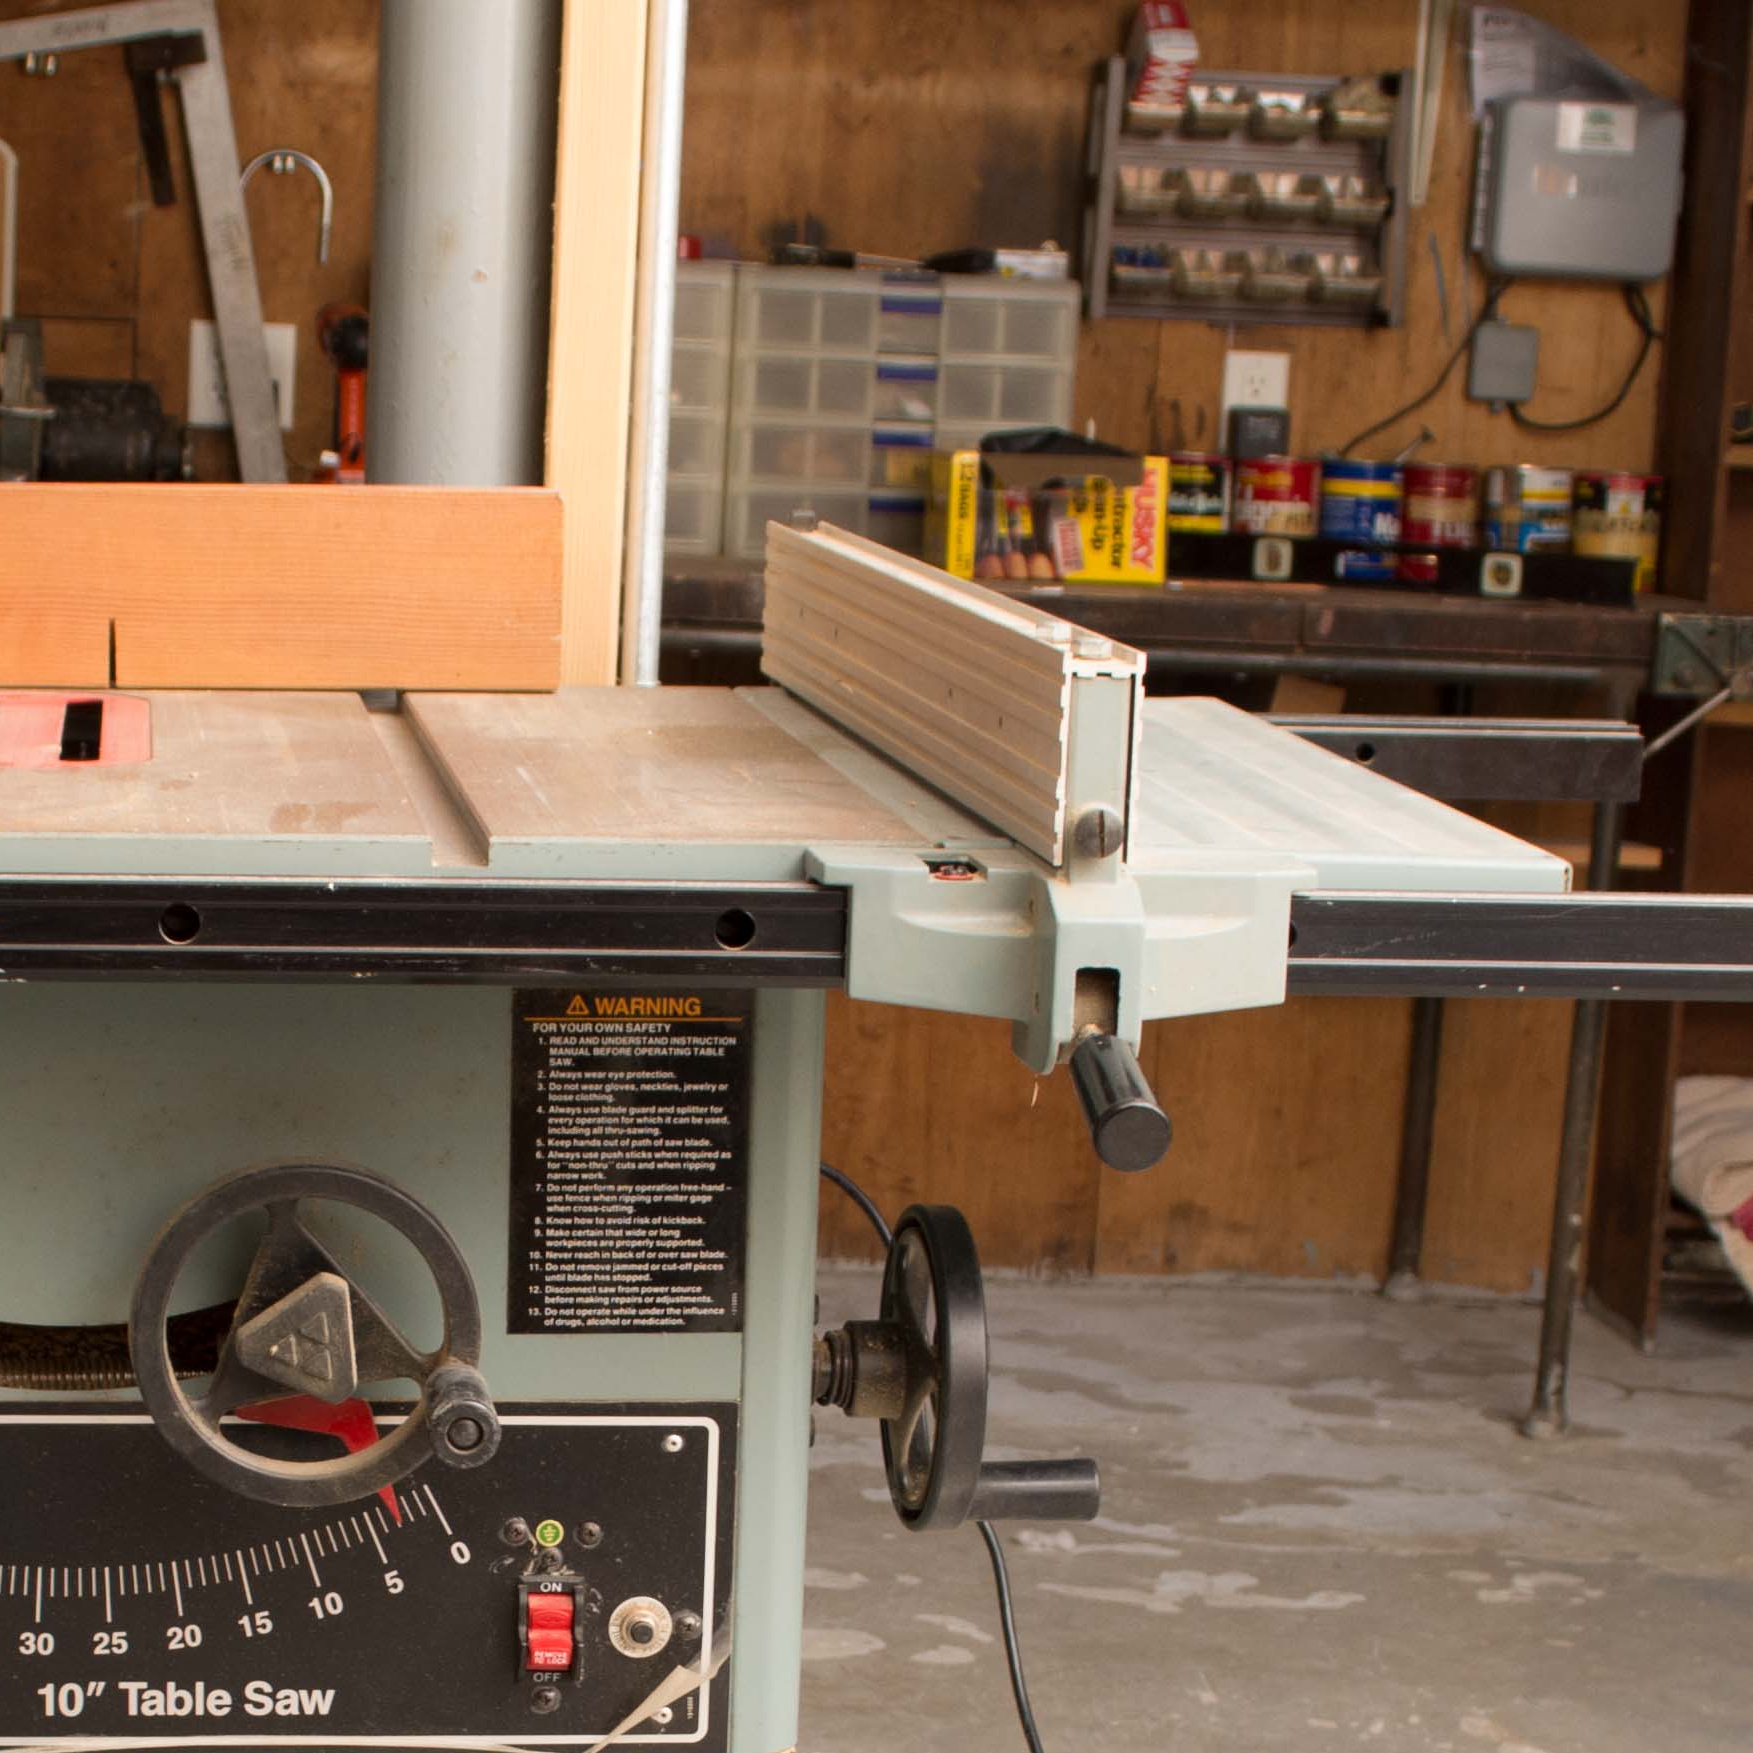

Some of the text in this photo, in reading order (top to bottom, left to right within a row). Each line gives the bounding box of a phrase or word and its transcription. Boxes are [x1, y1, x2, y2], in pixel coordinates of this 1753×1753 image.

[1129, 466, 1159, 571] HUSKY
[595, 997, 701, 1015] WARNING
[533, 1023, 671, 1033] FOR YOUR OWN SAFETY
[550, 1037, 577, 1045] READ
[602, 1037, 668, 1045] UNDERSTAND
[671, 1037, 736, 1045] INSTRUCTION
[550, 1048, 724, 1056] MANUAL BEFORE OPERATING TABLE
[549, 1071, 582, 1080] Always
[683, 1083, 716, 1093] jewelry
[548, 1093, 573, 1101] loose
[548, 1106, 581, 1116] Always
[602, 1106, 627, 1114] blade
[629, 1106, 656, 1116] guard
[676, 1106, 708, 1116] splitter
[548, 1118, 573, 1126] every
[575, 1117, 619, 1126] operation
[636, 1116, 663, 1124] which
[548, 1127, 591, 1136] including
[548, 1139, 571, 1148] Keep
[631, 1139, 652, 1148] path
[547, 1151, 581, 1161] Always
[601, 1151, 623, 1161] push
[625, 1151, 652, 1159] sticks
[654, 1151, 679, 1159] when
[681, 1151, 719, 1161] required
[657, 1161, 681, 1169] when
[683, 1161, 716, 1171] ripping
[575, 1251, 599, 1259] reach
[612, 1251, 634, 1259] back
[613, 1263, 649, 1273] jammed
[662, 1263, 693, 1271] cut-off
[694, 1263, 723, 1273] pieces
[568, 1273, 593, 1281] blade
[545, 1285, 596, 1293] Disconnect
[617, 1285, 639, 1293] from
[641, 1287, 668, 1295] power
[545, 1296, 574, 1304] before
[576, 1296, 609, 1305] making
[611, 1296, 643, 1305] repairs
[576, 1308, 611, 1317] operate
[540, 1582, 562, 1593] ON
[19, 1632, 55, 1655] 30
[93, 1632, 129, 1655] 25
[166, 1625, 203, 1650] 20
[238, 1611, 274, 1637] 15
[308, 1592, 344, 1619] 10
[384, 1570, 405, 1595] 5
[450, 1541, 471, 1565] 0
[533, 1672, 561, 1682] OFF
[37, 1681, 335, 1717] 10" Table Saw
